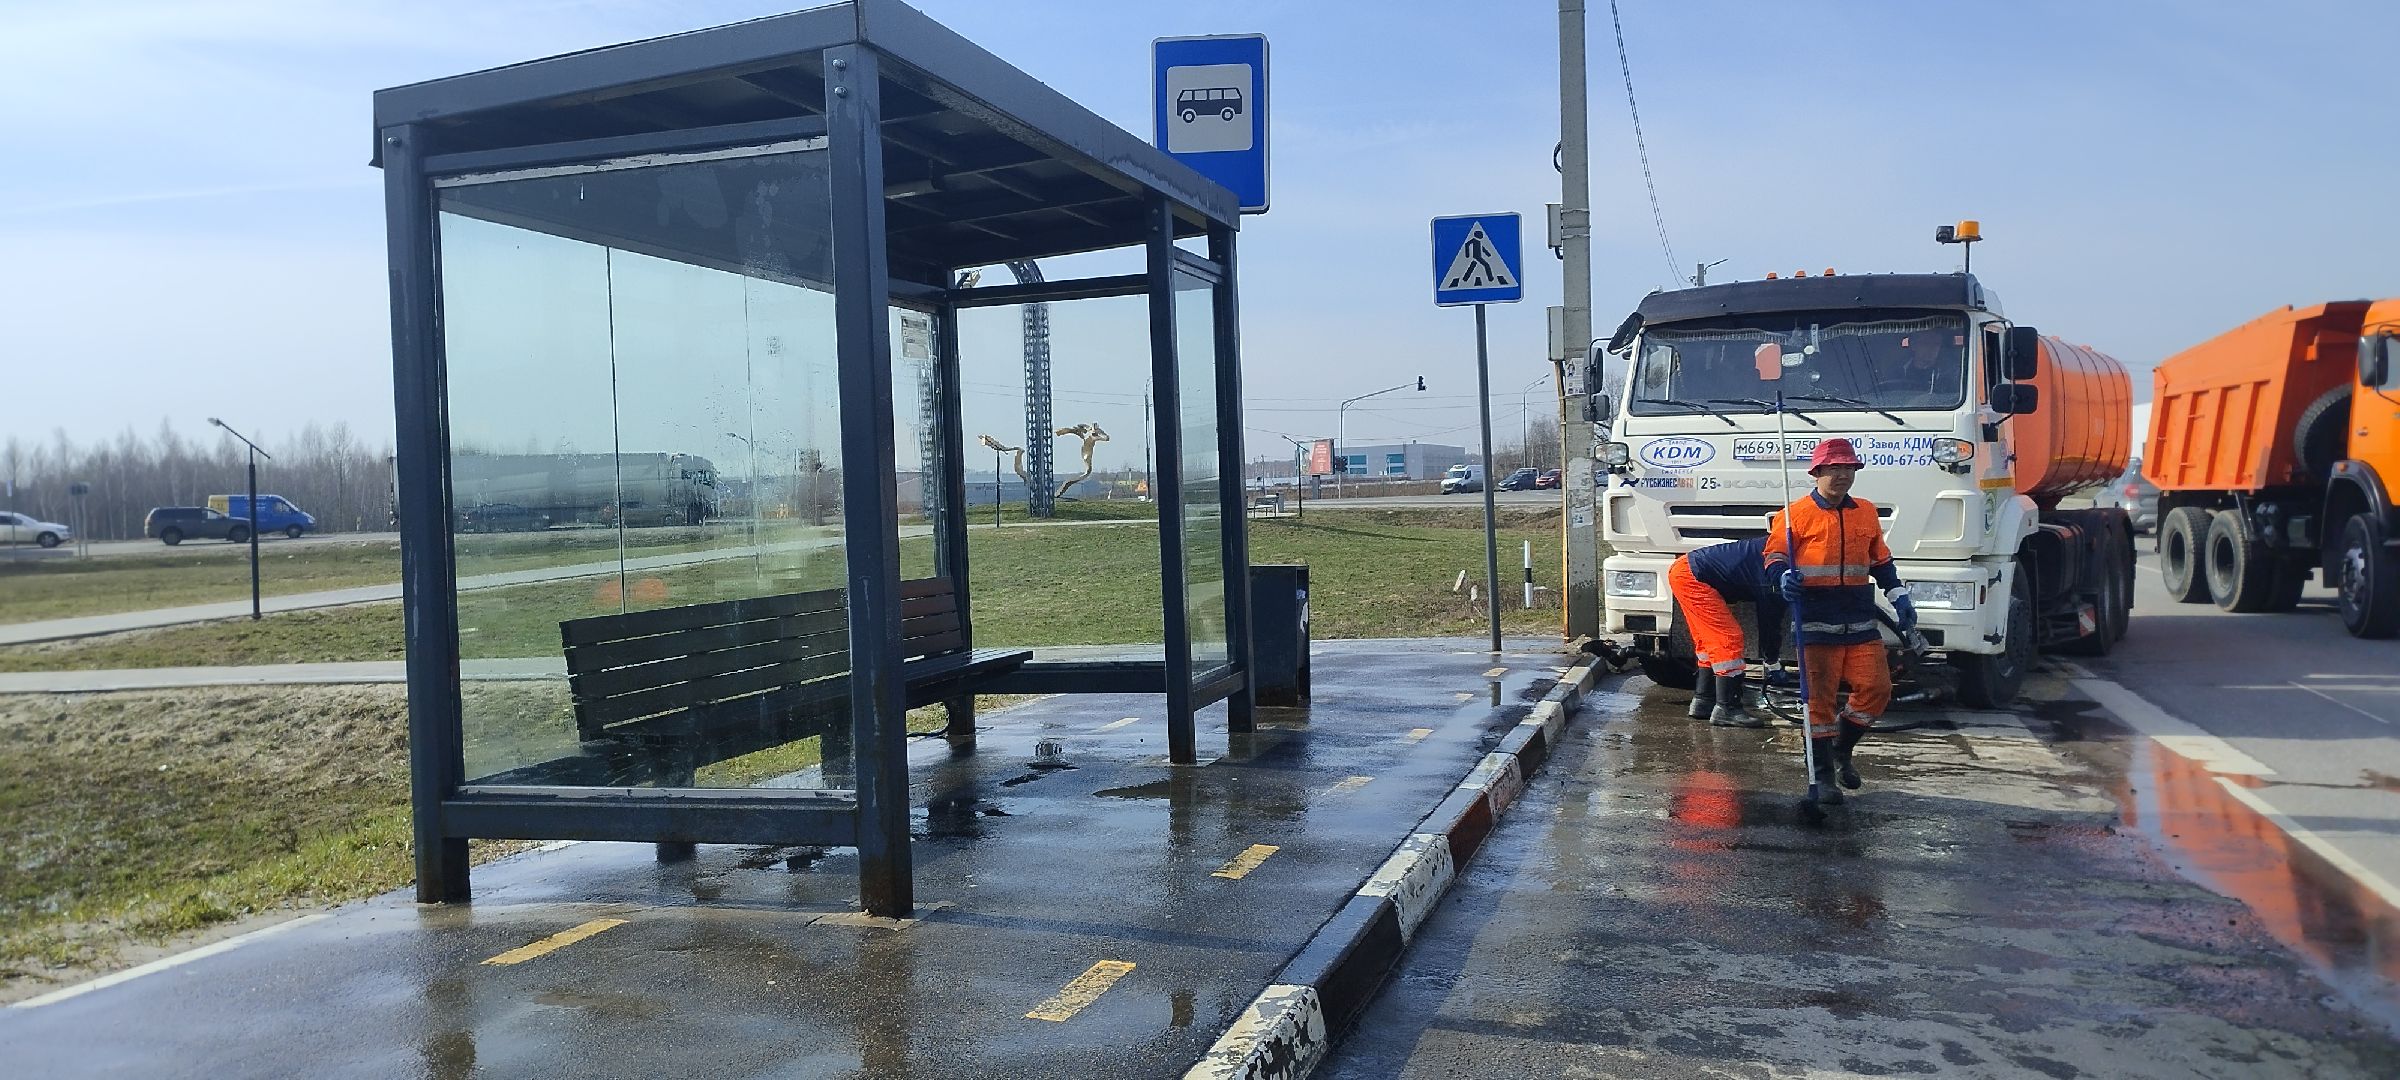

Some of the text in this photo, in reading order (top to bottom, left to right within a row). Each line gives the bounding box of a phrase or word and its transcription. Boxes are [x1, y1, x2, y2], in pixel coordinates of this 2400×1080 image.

[1794, 440, 1816, 451] 750
[1847, 437, 1863, 449] ОО
[1653, 446, 1702, 459] KDM
